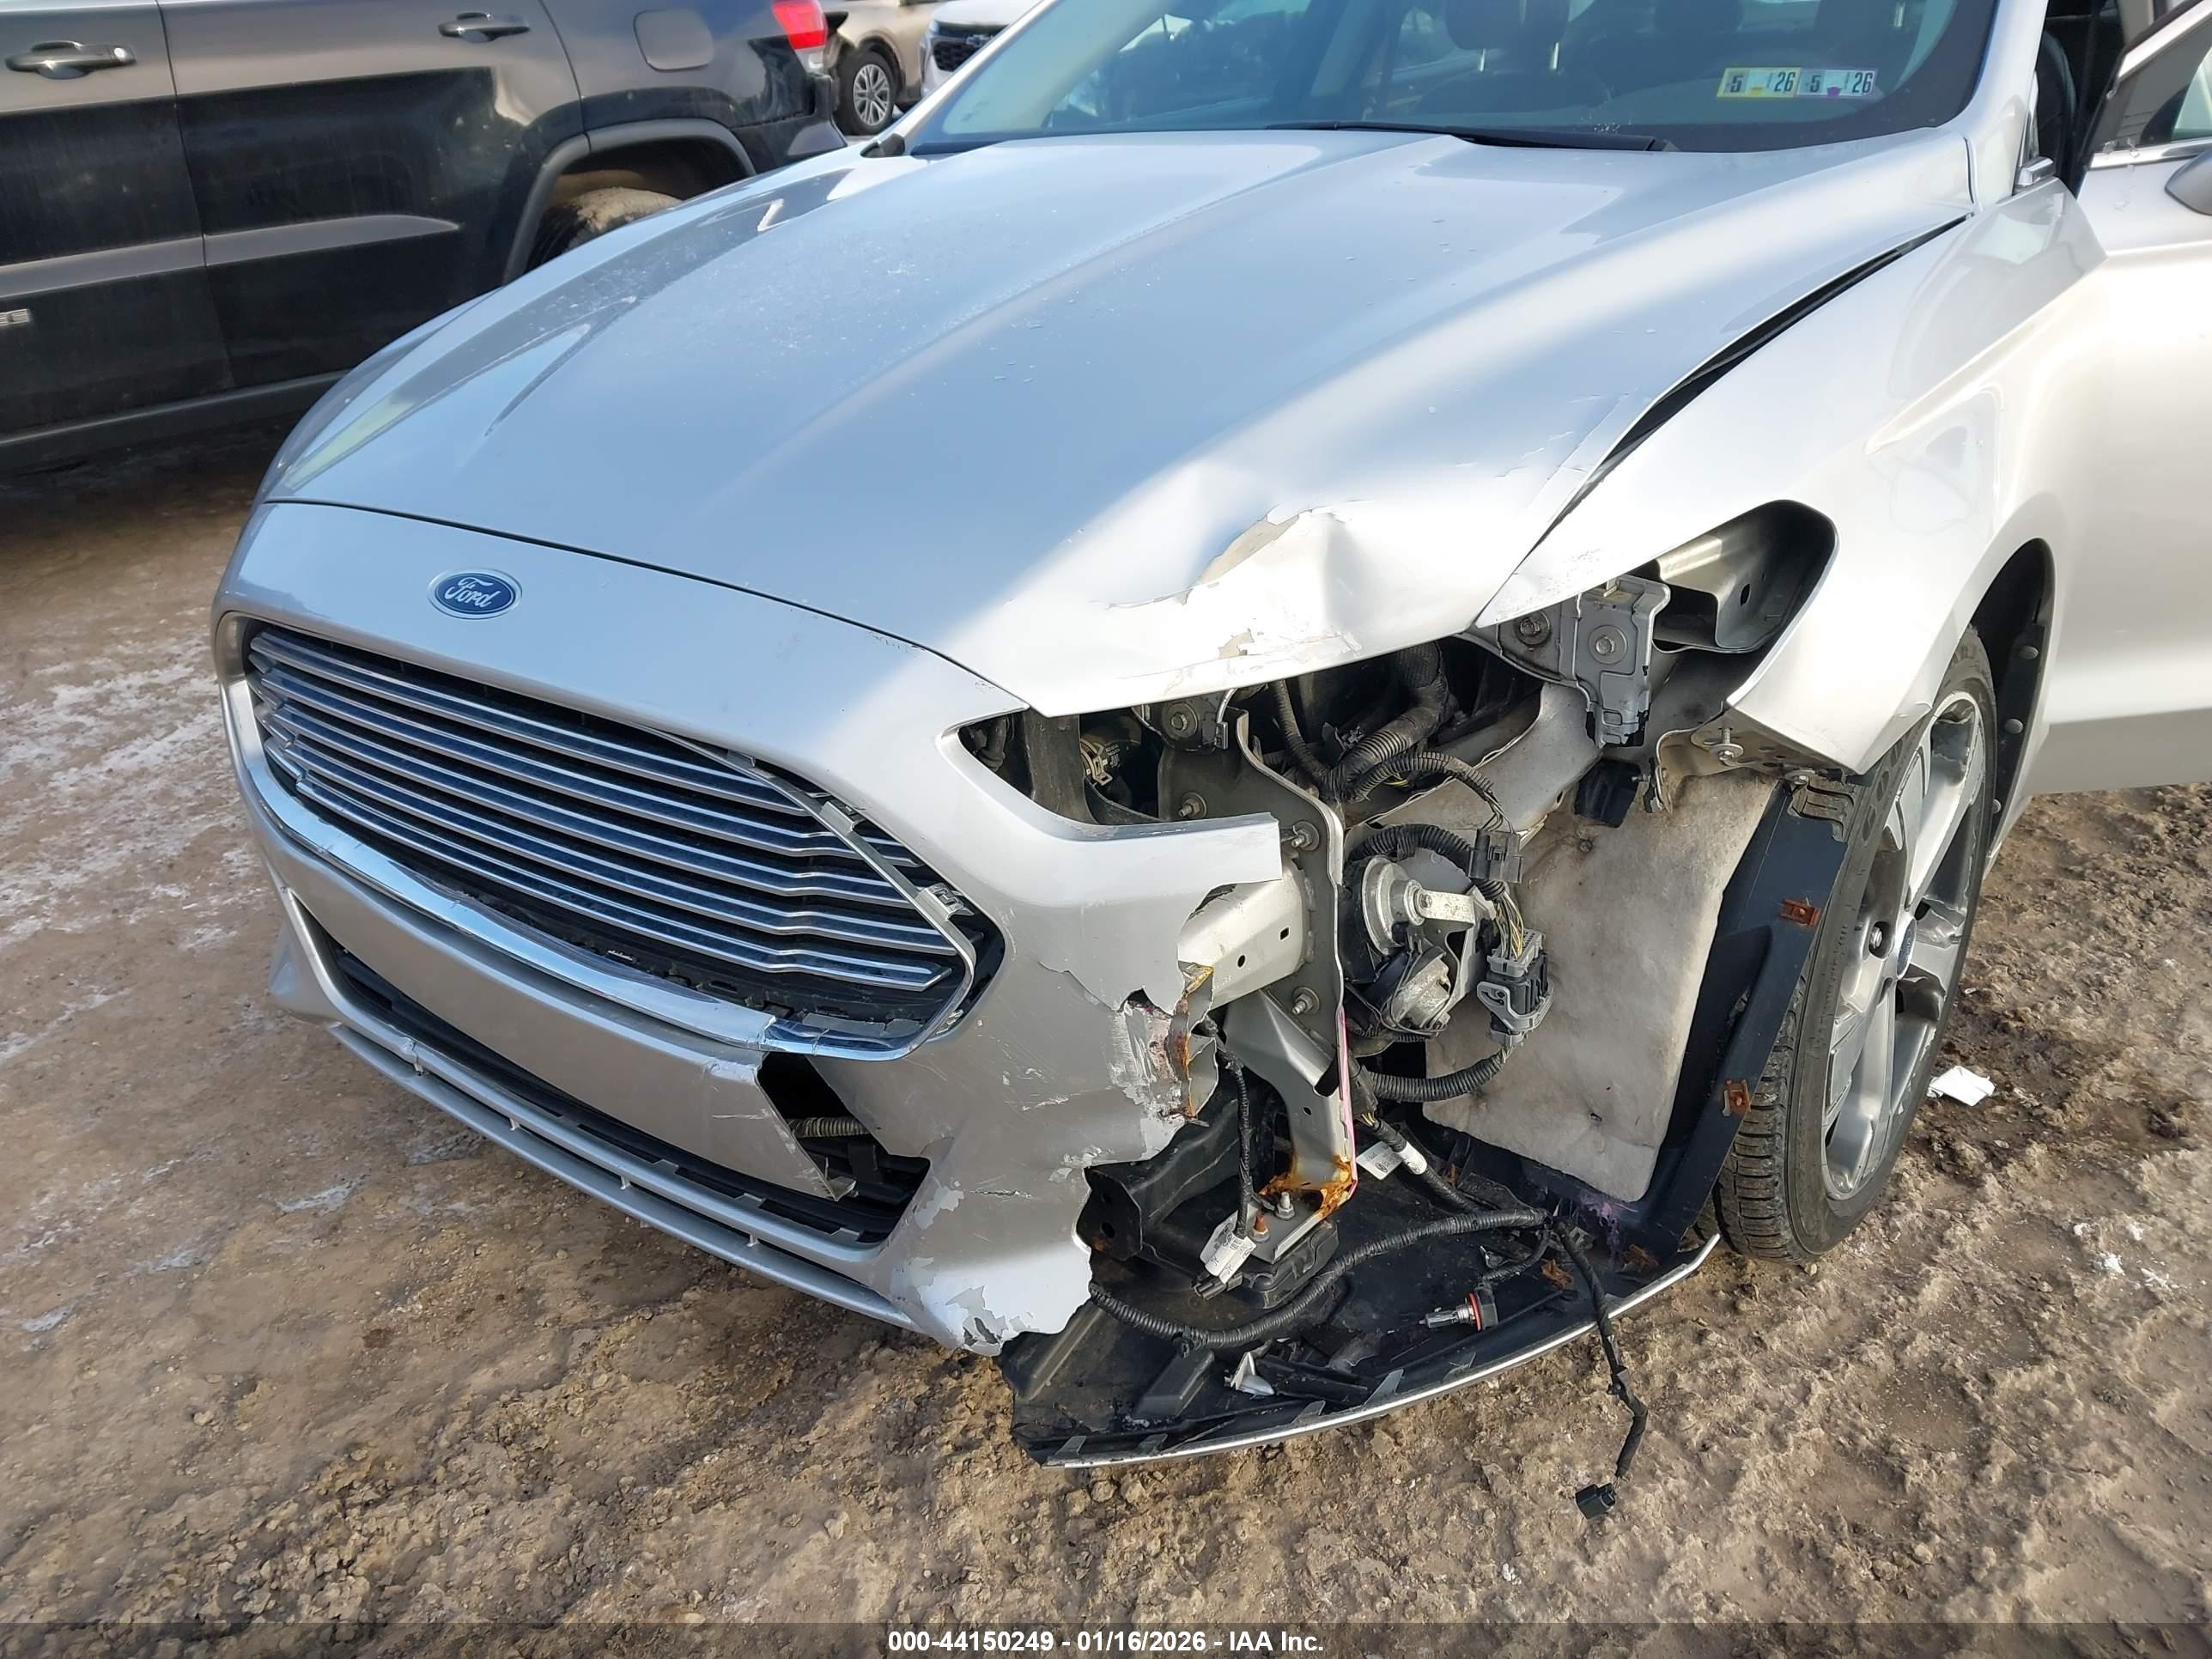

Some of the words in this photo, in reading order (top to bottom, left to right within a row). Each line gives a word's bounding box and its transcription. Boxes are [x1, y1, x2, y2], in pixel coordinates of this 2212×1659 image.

[1729, 75, 1743, 94] 5
[1773, 71, 1796, 92] 26
[1809, 75, 1821, 94] 5
[1851, 71, 1874, 94] 26
[444, 576, 501, 608] Ford
